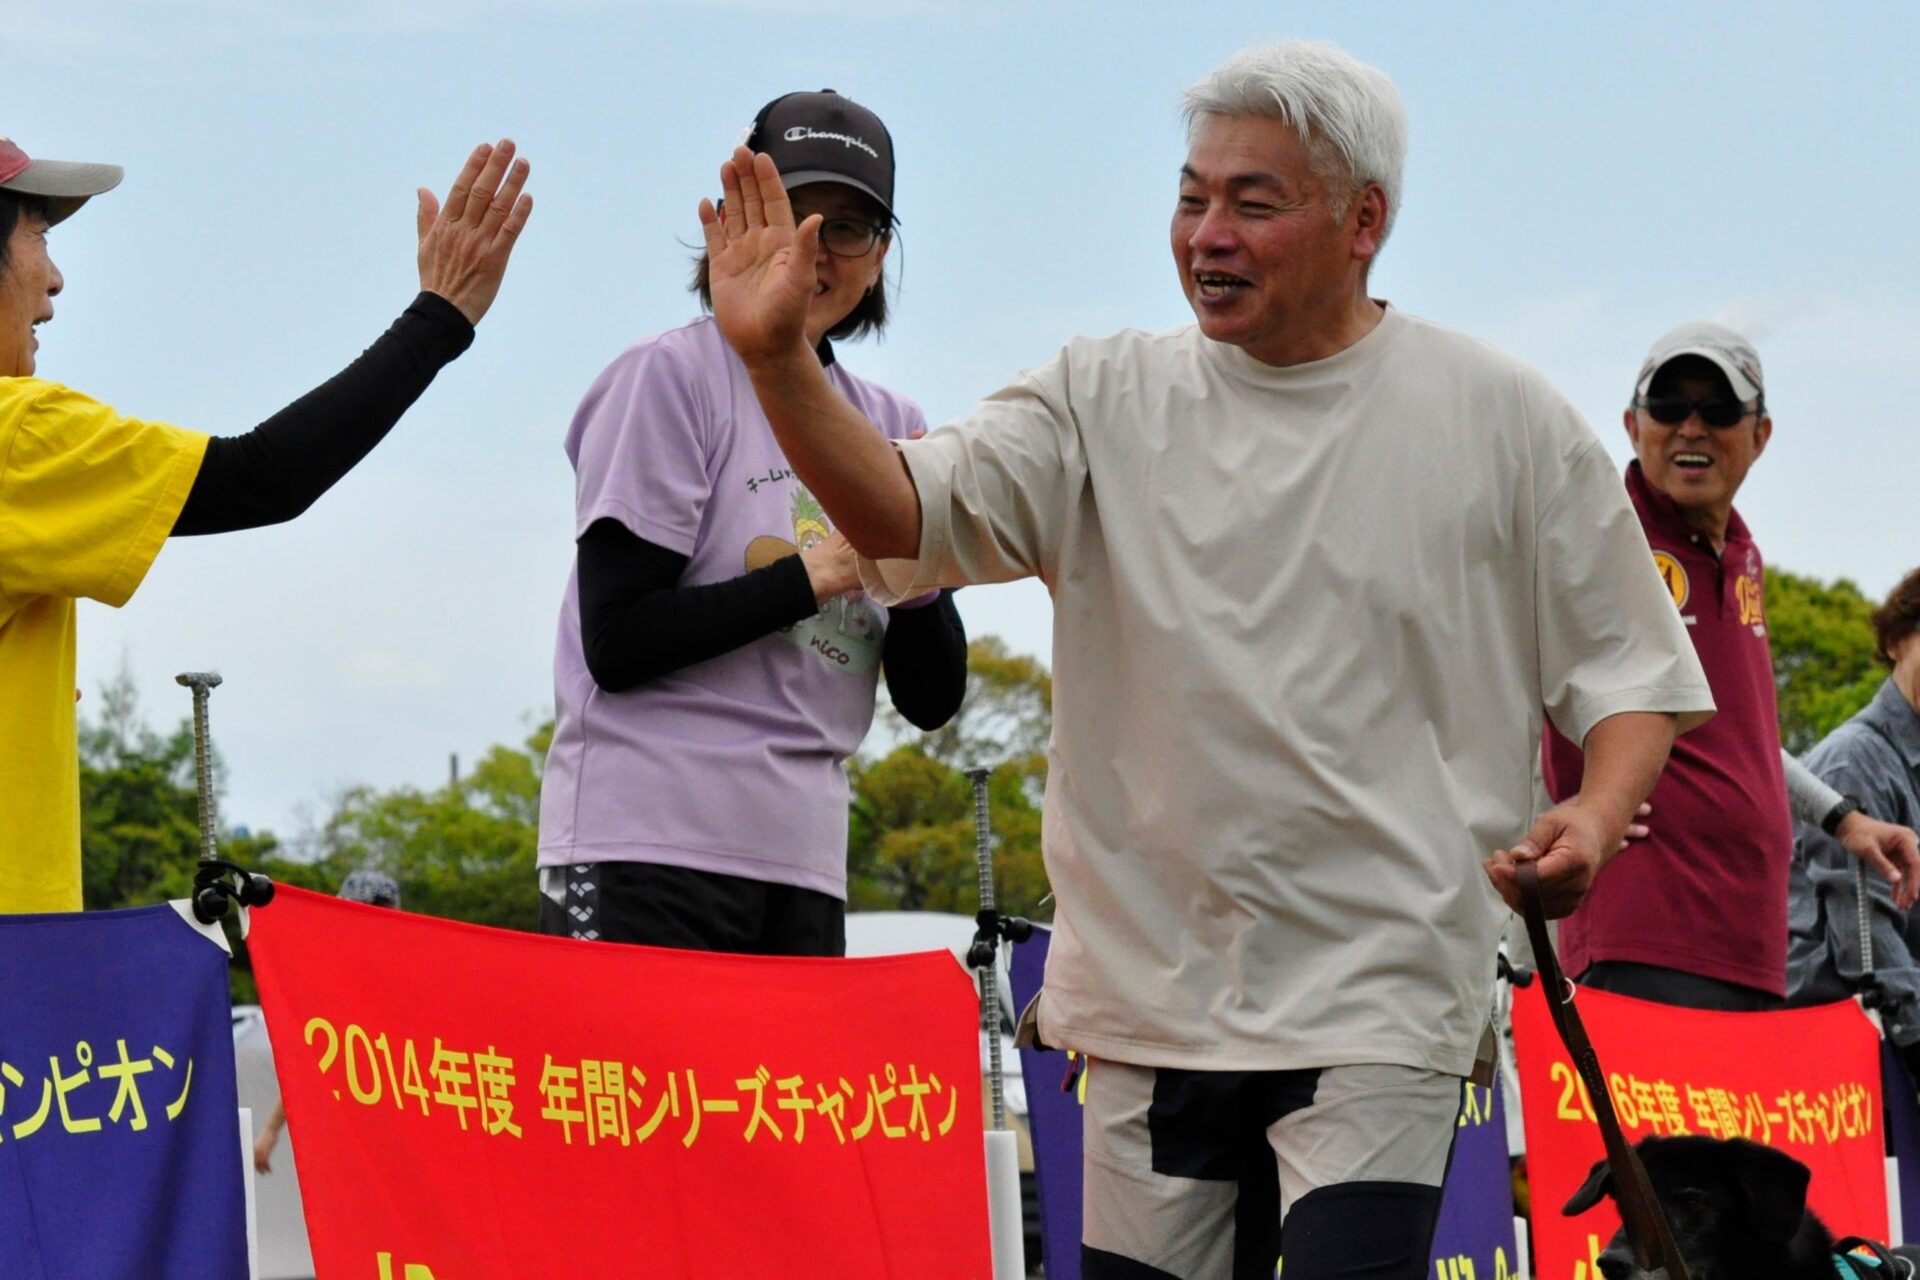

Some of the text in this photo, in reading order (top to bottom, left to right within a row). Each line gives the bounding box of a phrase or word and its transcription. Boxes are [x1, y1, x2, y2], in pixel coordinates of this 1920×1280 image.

[784, 126, 879, 159] Champion
[809, 634, 850, 665] nico
[303, 1016, 523, 1139] 2014年度
[537, 1053, 958, 1148] 年間シリーズチャンピオン
